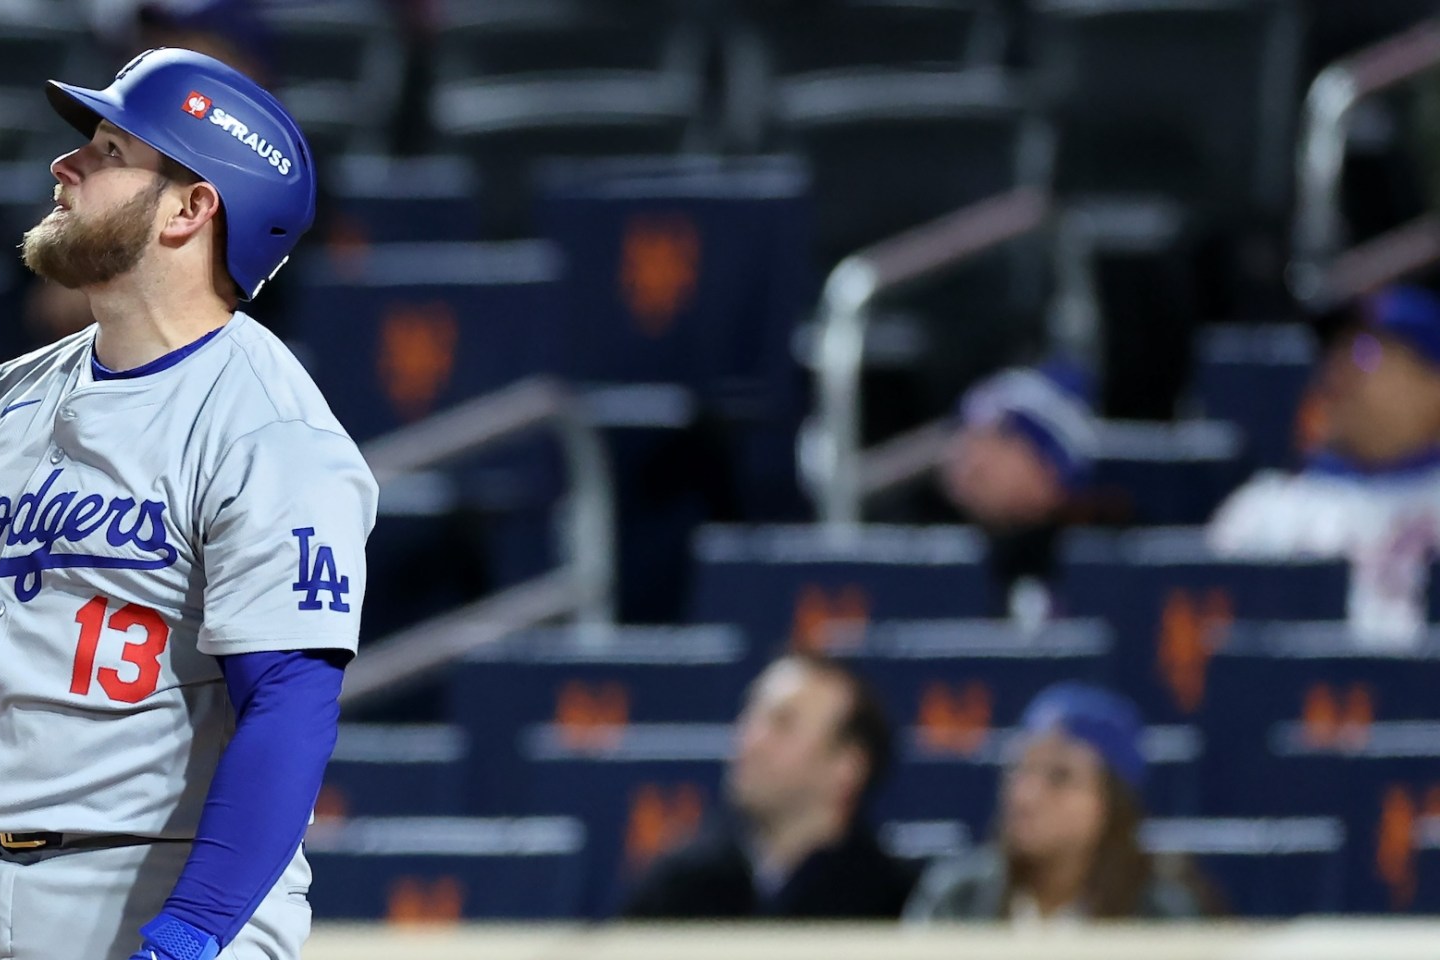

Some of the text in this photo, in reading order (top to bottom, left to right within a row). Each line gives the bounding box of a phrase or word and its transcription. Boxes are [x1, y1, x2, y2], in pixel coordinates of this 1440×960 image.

[208, 107, 292, 176] STRAUSS
[292, 527, 350, 613] LA
[69, 595, 170, 703] 13
